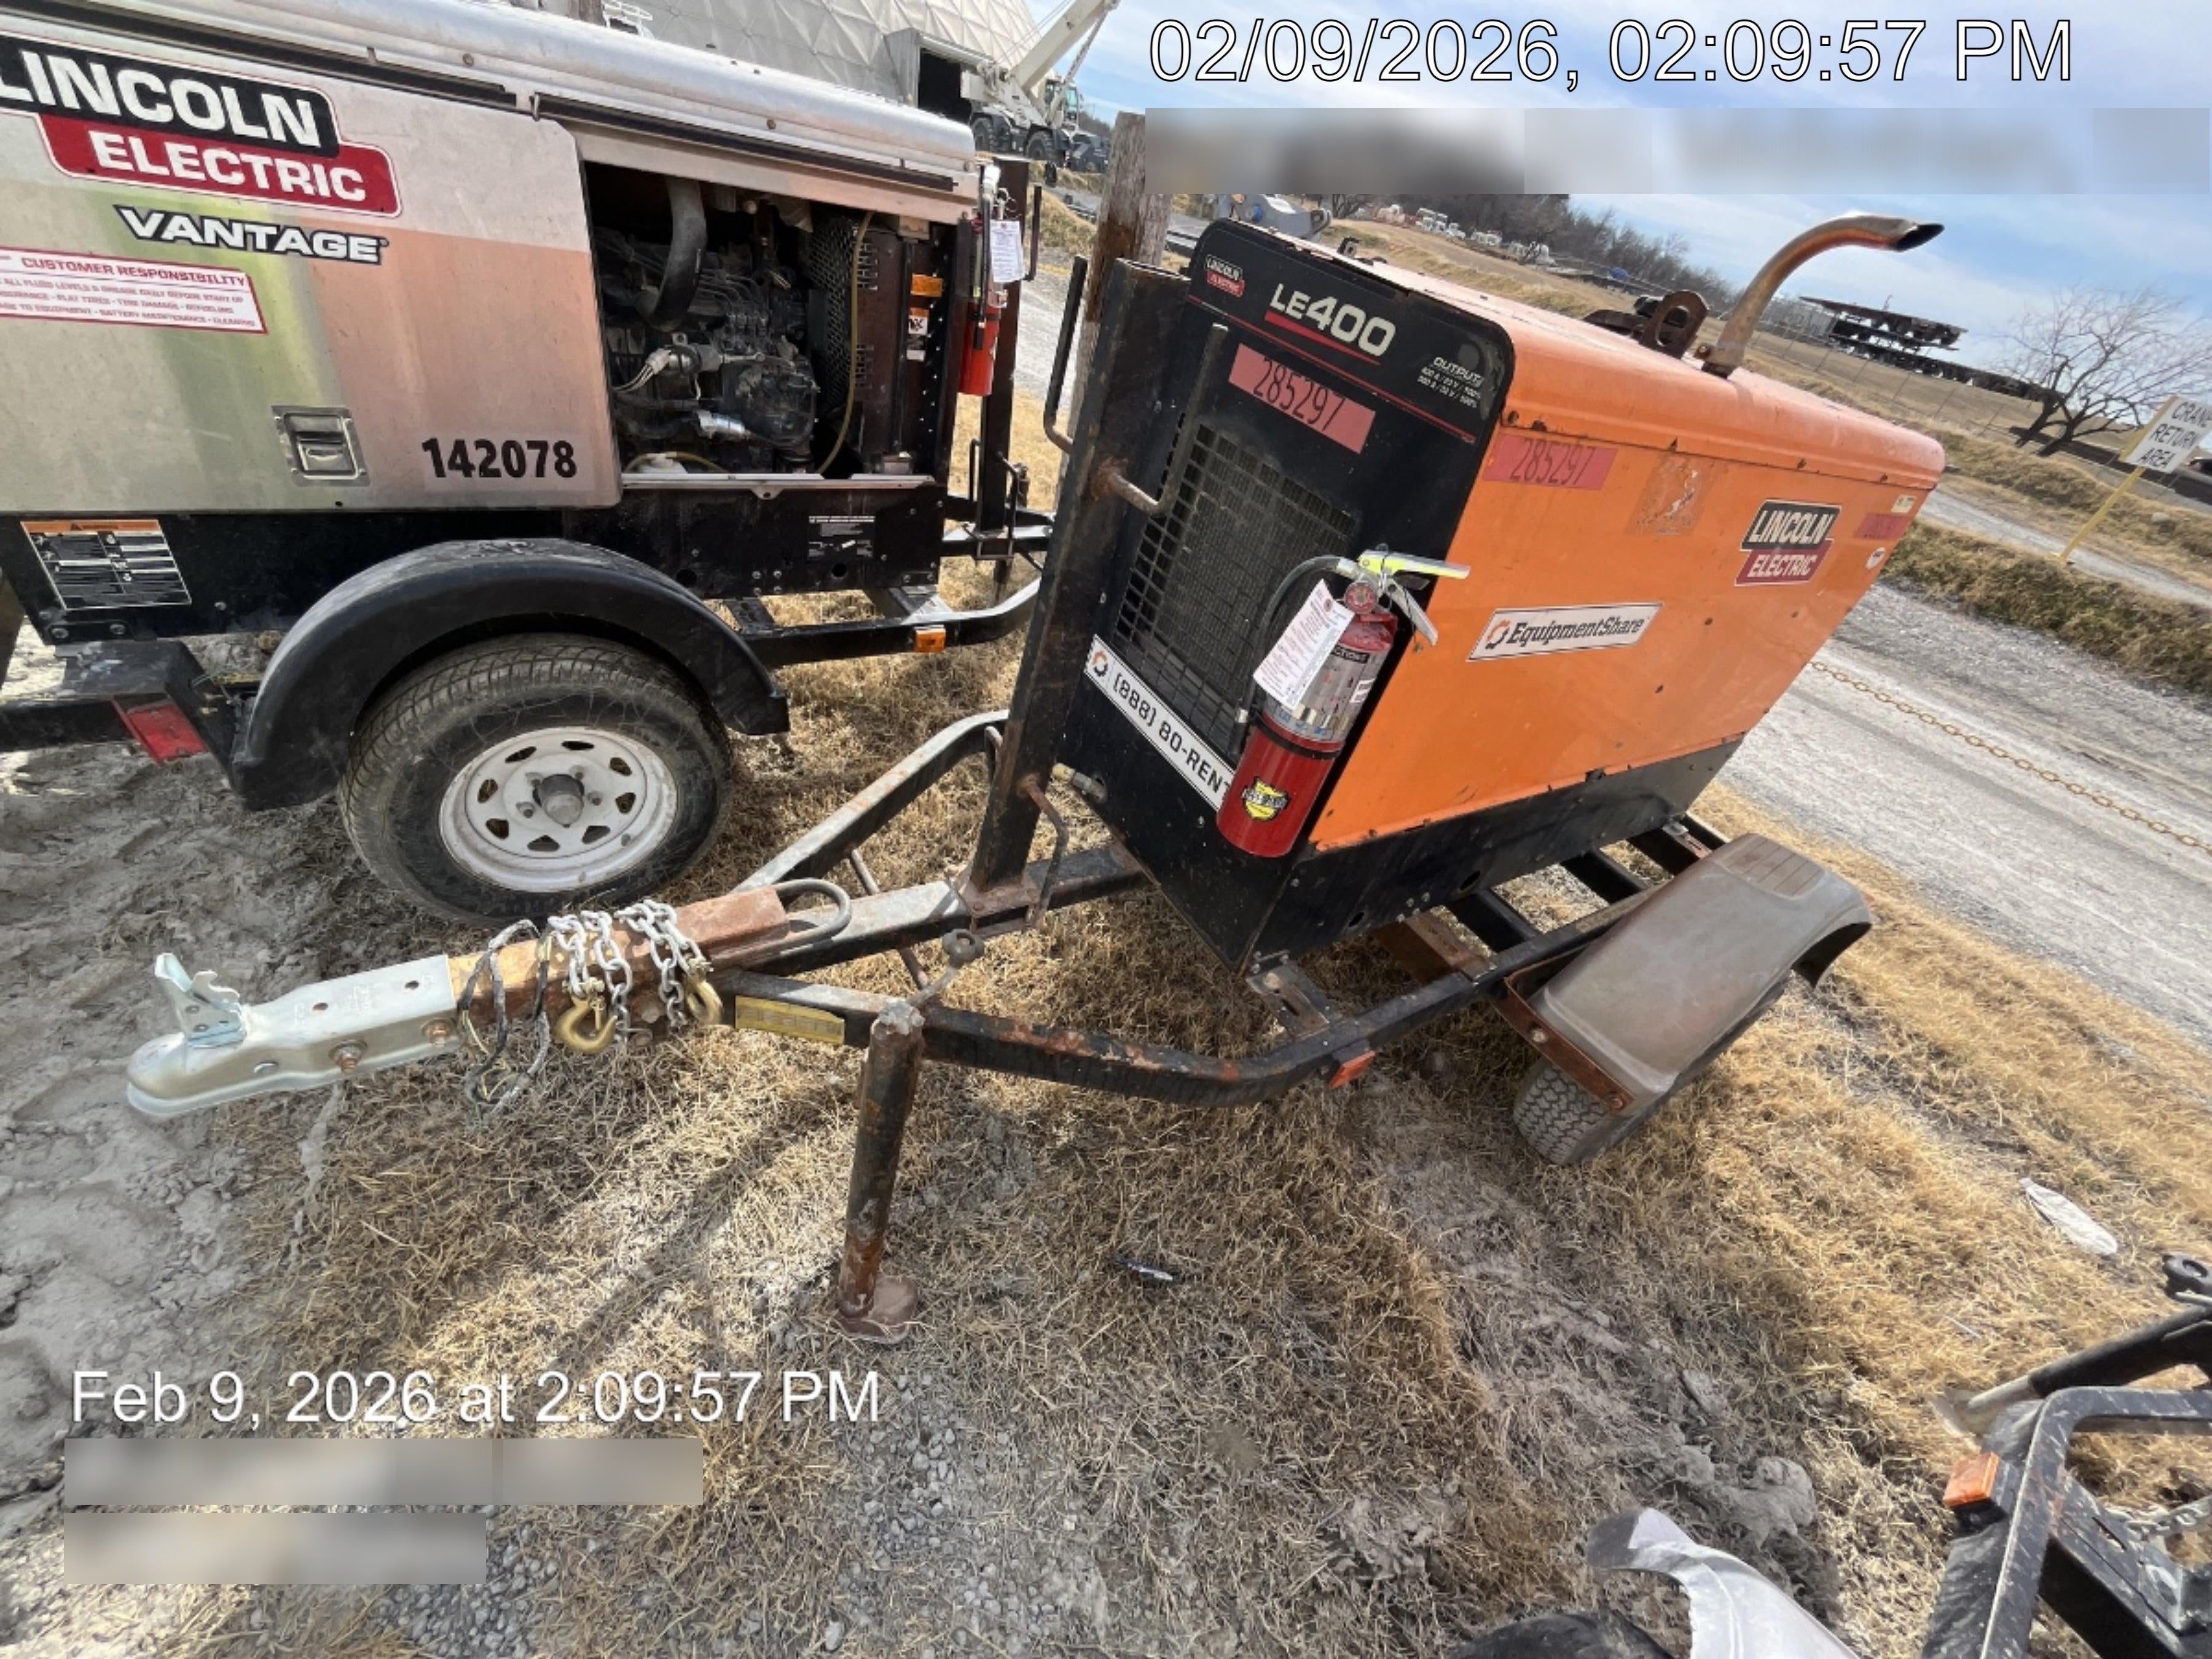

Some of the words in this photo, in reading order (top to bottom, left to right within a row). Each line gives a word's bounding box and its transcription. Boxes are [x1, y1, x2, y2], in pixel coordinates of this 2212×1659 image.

[88, 130, 366, 202] ELECTRIC
[120, 207, 380, 263] VANTAGE
[22, 257, 114, 275] CUSTOMER
[116, 265, 245, 286] RESPONSIBILITY
[1269, 283, 1397, 357] LE400
[1433, 356, 1483, 383] OUTPUT
[1252, 356, 1347, 432] 285297
[422, 437, 576, 478] 142078
[1509, 437, 1597, 485] 285297
[2137, 448, 2176, 468] AREA
[1747, 509, 1835, 544] LINCOLN
[1746, 554, 1818, 578] ELECTRIC
[1505, 615, 1645, 647] EquipmentShare
[1112, 673, 1157, 727] (888)
